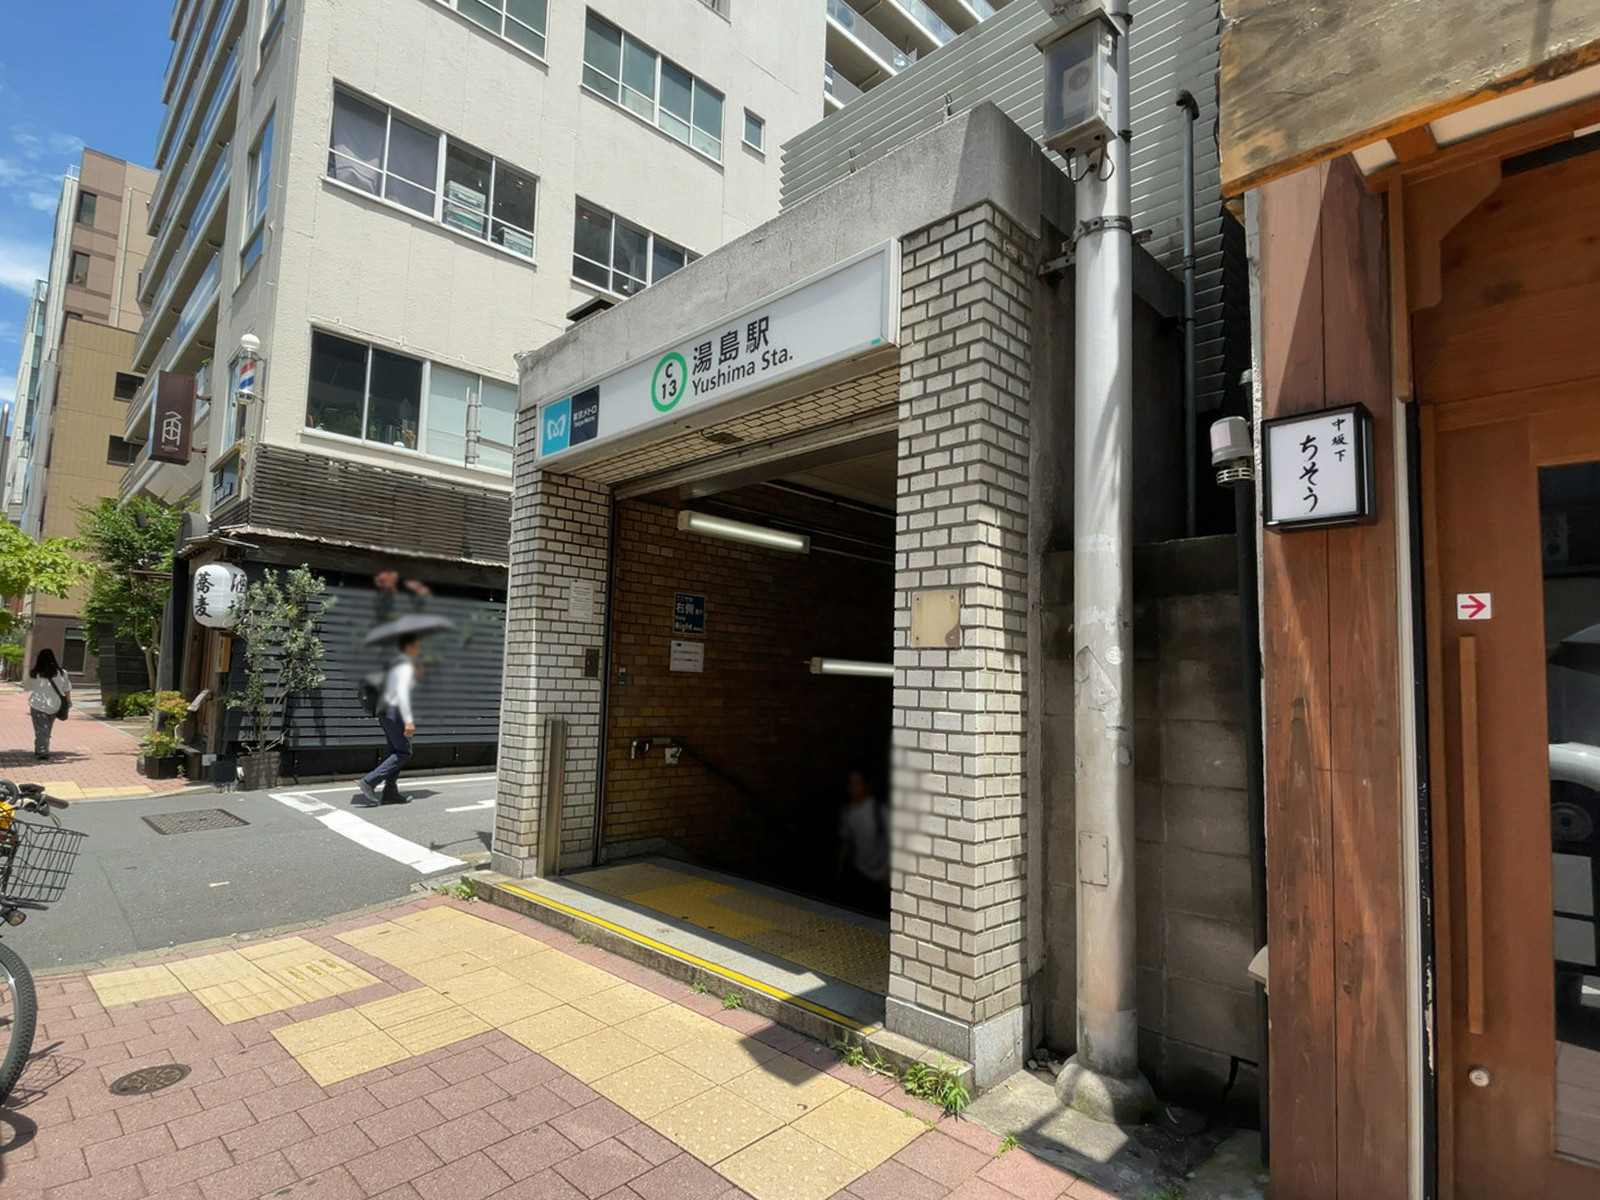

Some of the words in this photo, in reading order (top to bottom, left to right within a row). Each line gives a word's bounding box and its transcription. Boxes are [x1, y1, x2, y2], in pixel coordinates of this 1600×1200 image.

[692, 315, 769, 376] 湯島駅
[662, 379, 677, 400] 13
[665, 363, 673, 378] C
[692, 361, 756, 396] Yushima
[761, 348, 793, 371] Sta.
[1331, 418, 1348, 462] 中坂下
[1299, 435, 1319, 513] ちそう
[195, 571, 215, 618] 蕎麦
